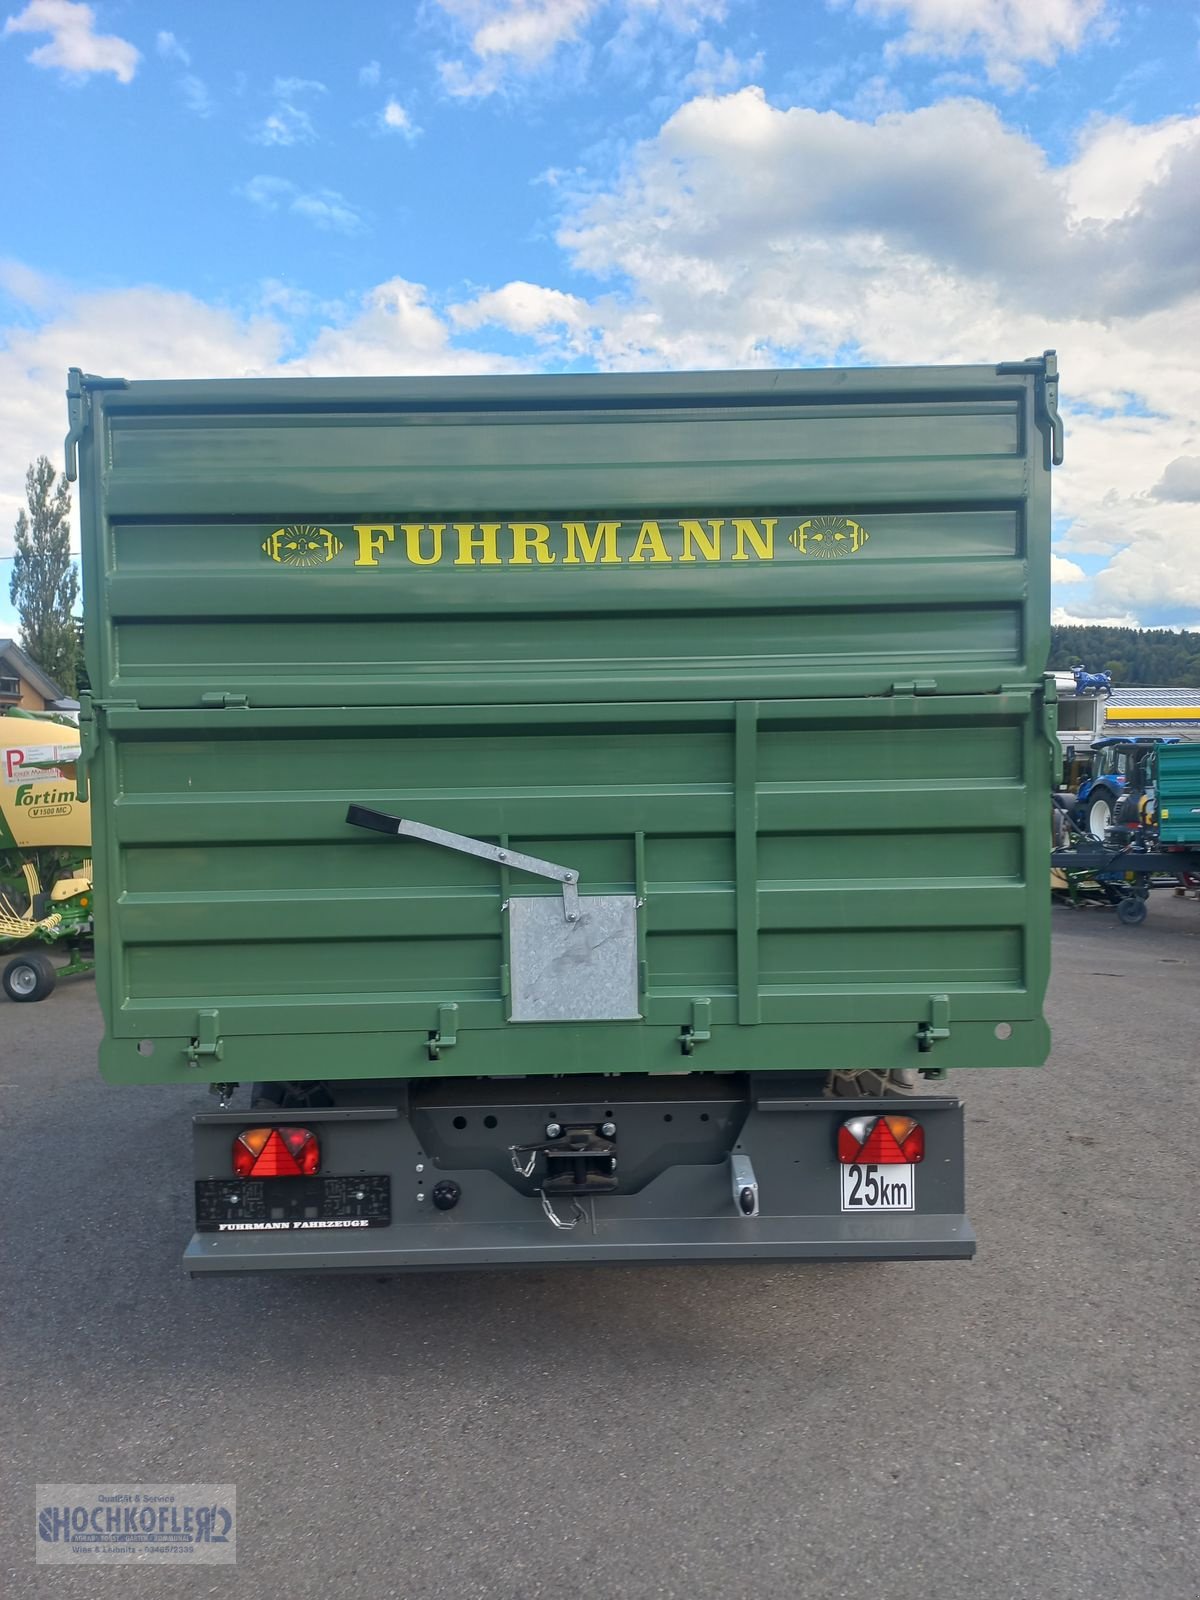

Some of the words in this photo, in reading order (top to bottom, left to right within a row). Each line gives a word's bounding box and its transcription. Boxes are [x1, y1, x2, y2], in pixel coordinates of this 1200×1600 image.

[353, 519, 778, 567] FUHRMANN
[15, 784, 77, 806] Fortim
[848, 1164, 907, 1206] 25km
[219, 1221, 290, 1231] FUHRMANN
[293, 1219, 369, 1230] FAHRZEUGE
